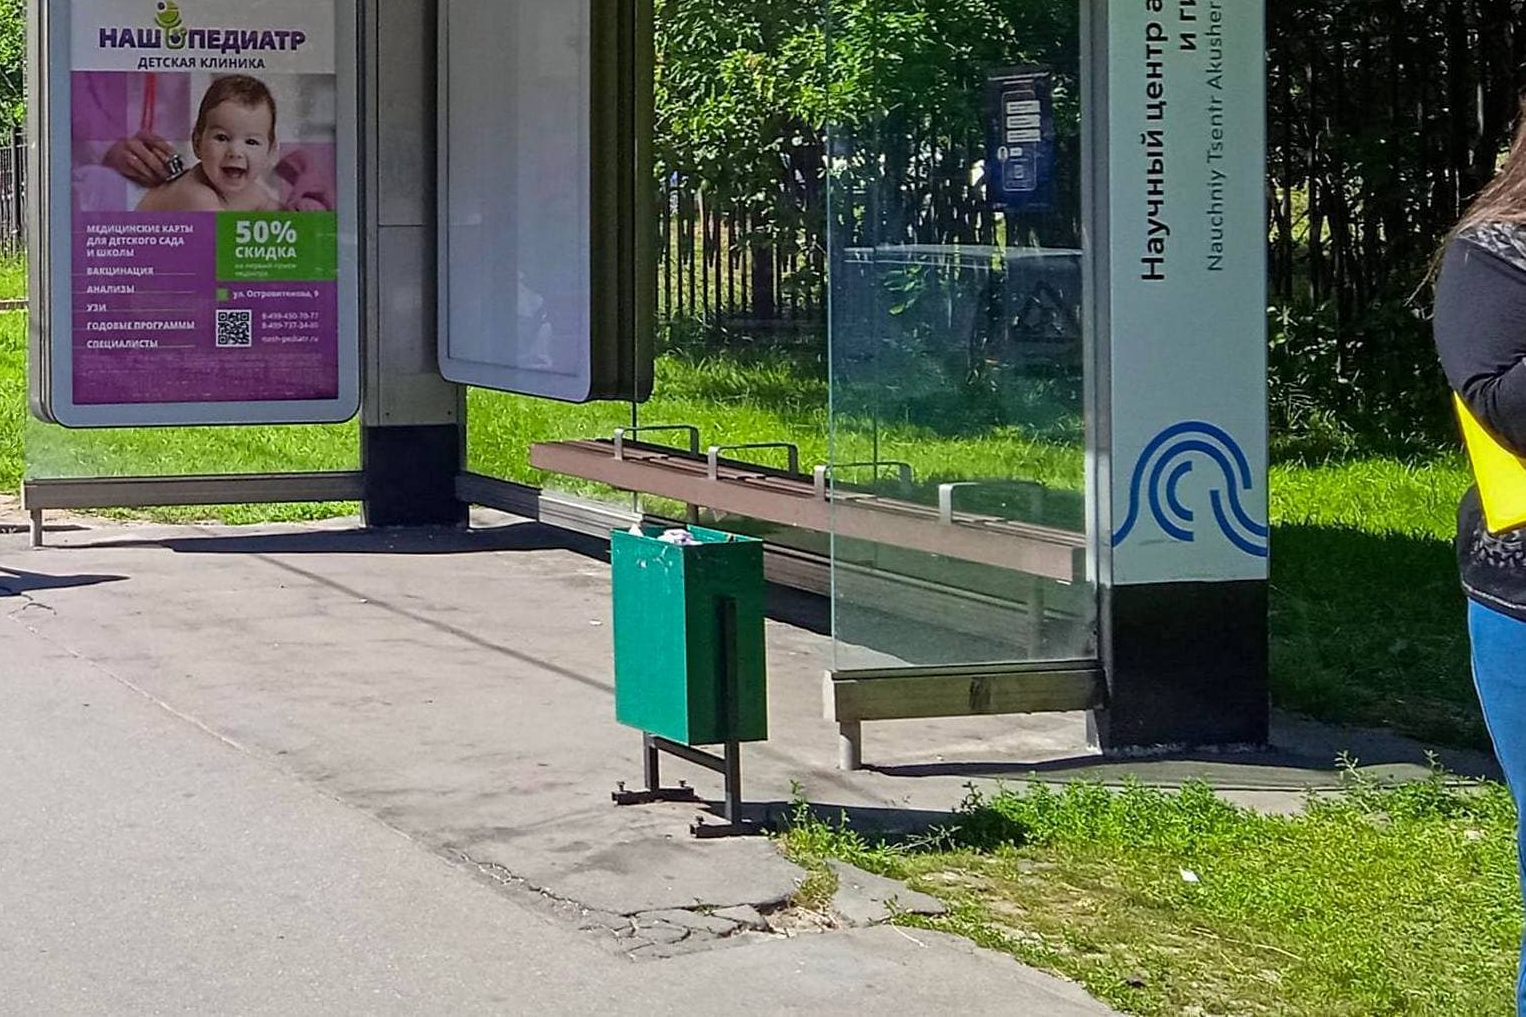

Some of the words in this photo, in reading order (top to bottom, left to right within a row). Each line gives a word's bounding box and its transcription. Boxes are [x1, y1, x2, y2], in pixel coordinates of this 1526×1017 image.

[99, 28, 161, 49] НАШ
[188, 29, 306, 54] ПЕДИАТР
[1179, 32, 1197, 51] и
[137, 56, 196, 70] ДЕТСКАЯ
[200, 57, 265, 69] КЛИНИКА
[1146, 22, 1169, 120] центр
[1206, 95, 1223, 163] Tsentr
[1141, 131, 1170, 281] Научный
[1207, 170, 1227, 271] Nauchniy
[86, 224, 160, 234] МЕДИЦИНСКИЕ
[162, 224, 194, 233] КАРТЫ
[235, 220, 297, 243] 50%
[86, 236, 107, 246] ДЛЯ
[108, 236, 157, 246] ДЕТСКОГО
[159, 236, 185, 246] САДА
[86, 249, 95, 257] И
[96, 248, 134, 257] ШКОЛЫ
[235, 246, 297, 260] СКИДКА
[86, 267, 154, 276] ВАКЦИНАЦИЯ
[86, 285, 135, 294] АНАЛИЗЫ
[86, 303, 107, 312] УЗИ
[86, 321, 133, 331] ГОДОВЫЕ
[134, 321, 195, 330] ПРОГРАММЫ
[86, 339, 159, 349] СПЕЦИАЛИСТЫ
